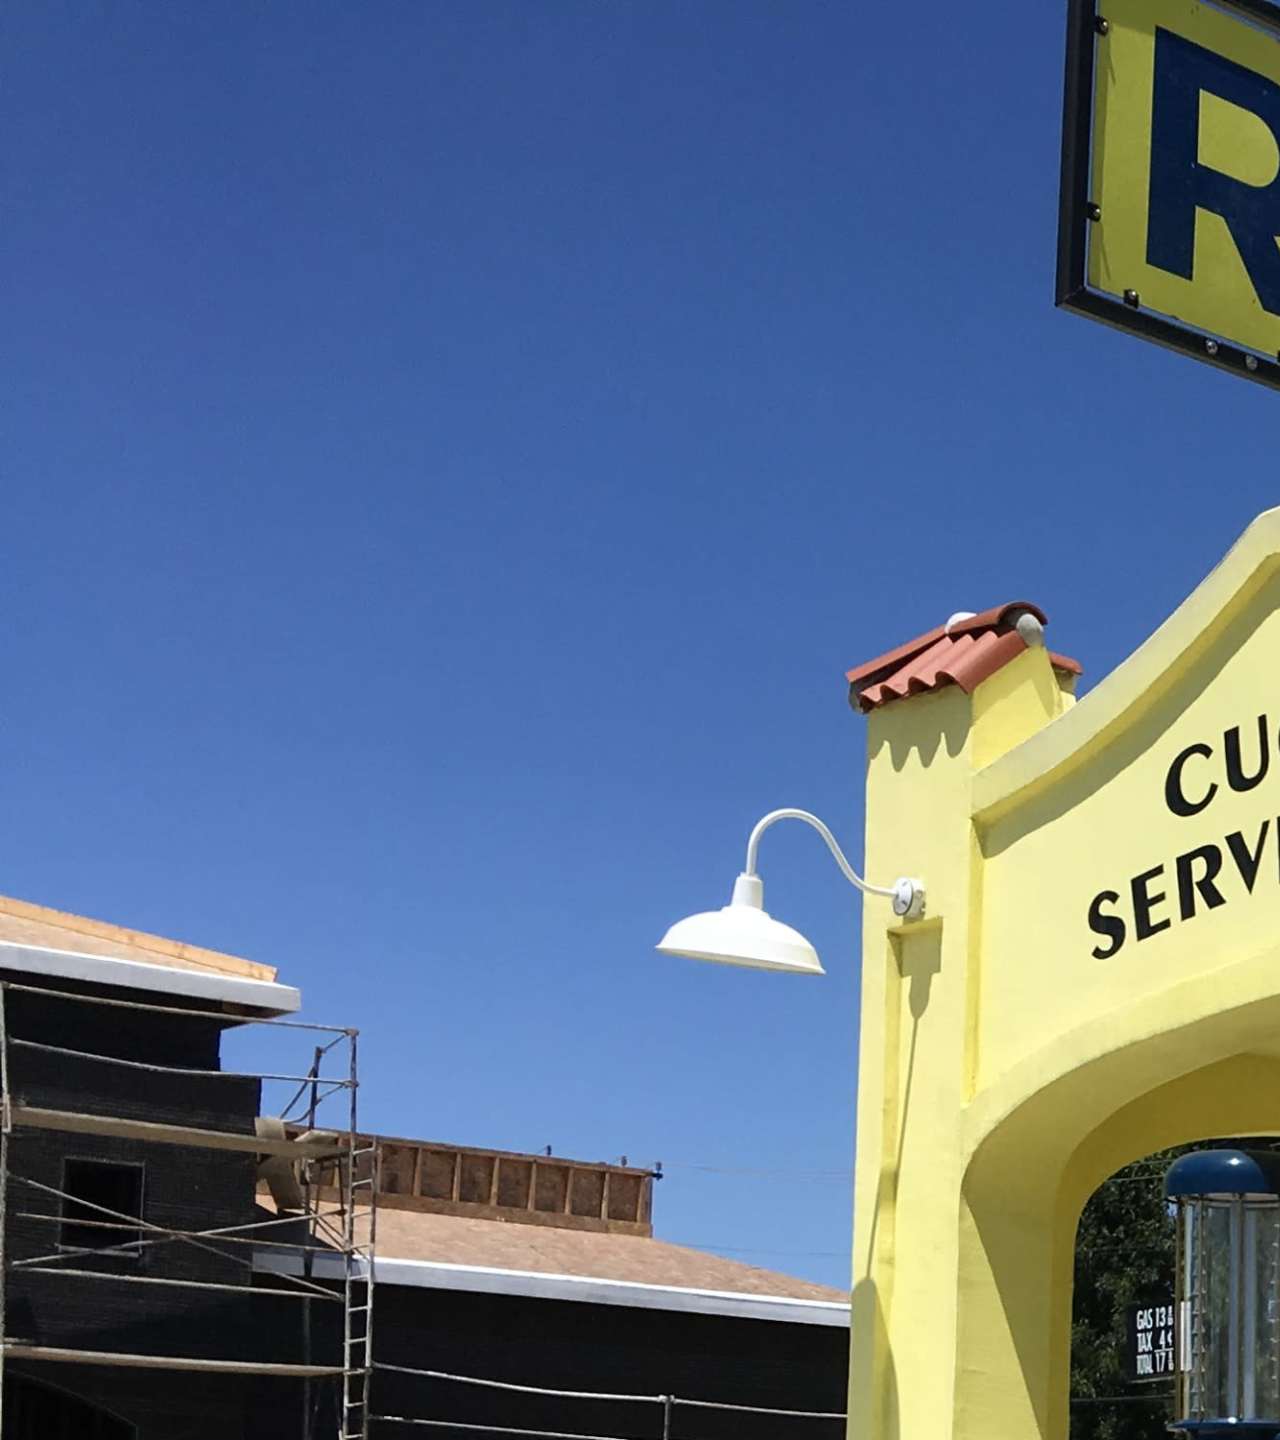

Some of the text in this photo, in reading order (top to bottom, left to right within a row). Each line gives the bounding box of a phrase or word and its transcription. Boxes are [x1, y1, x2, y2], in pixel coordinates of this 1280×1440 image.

[1136, 1308, 1153, 1330] GAS
[1155, 1306, 1166, 1328] 13
[1136, 1331, 1152, 1353] TAX
